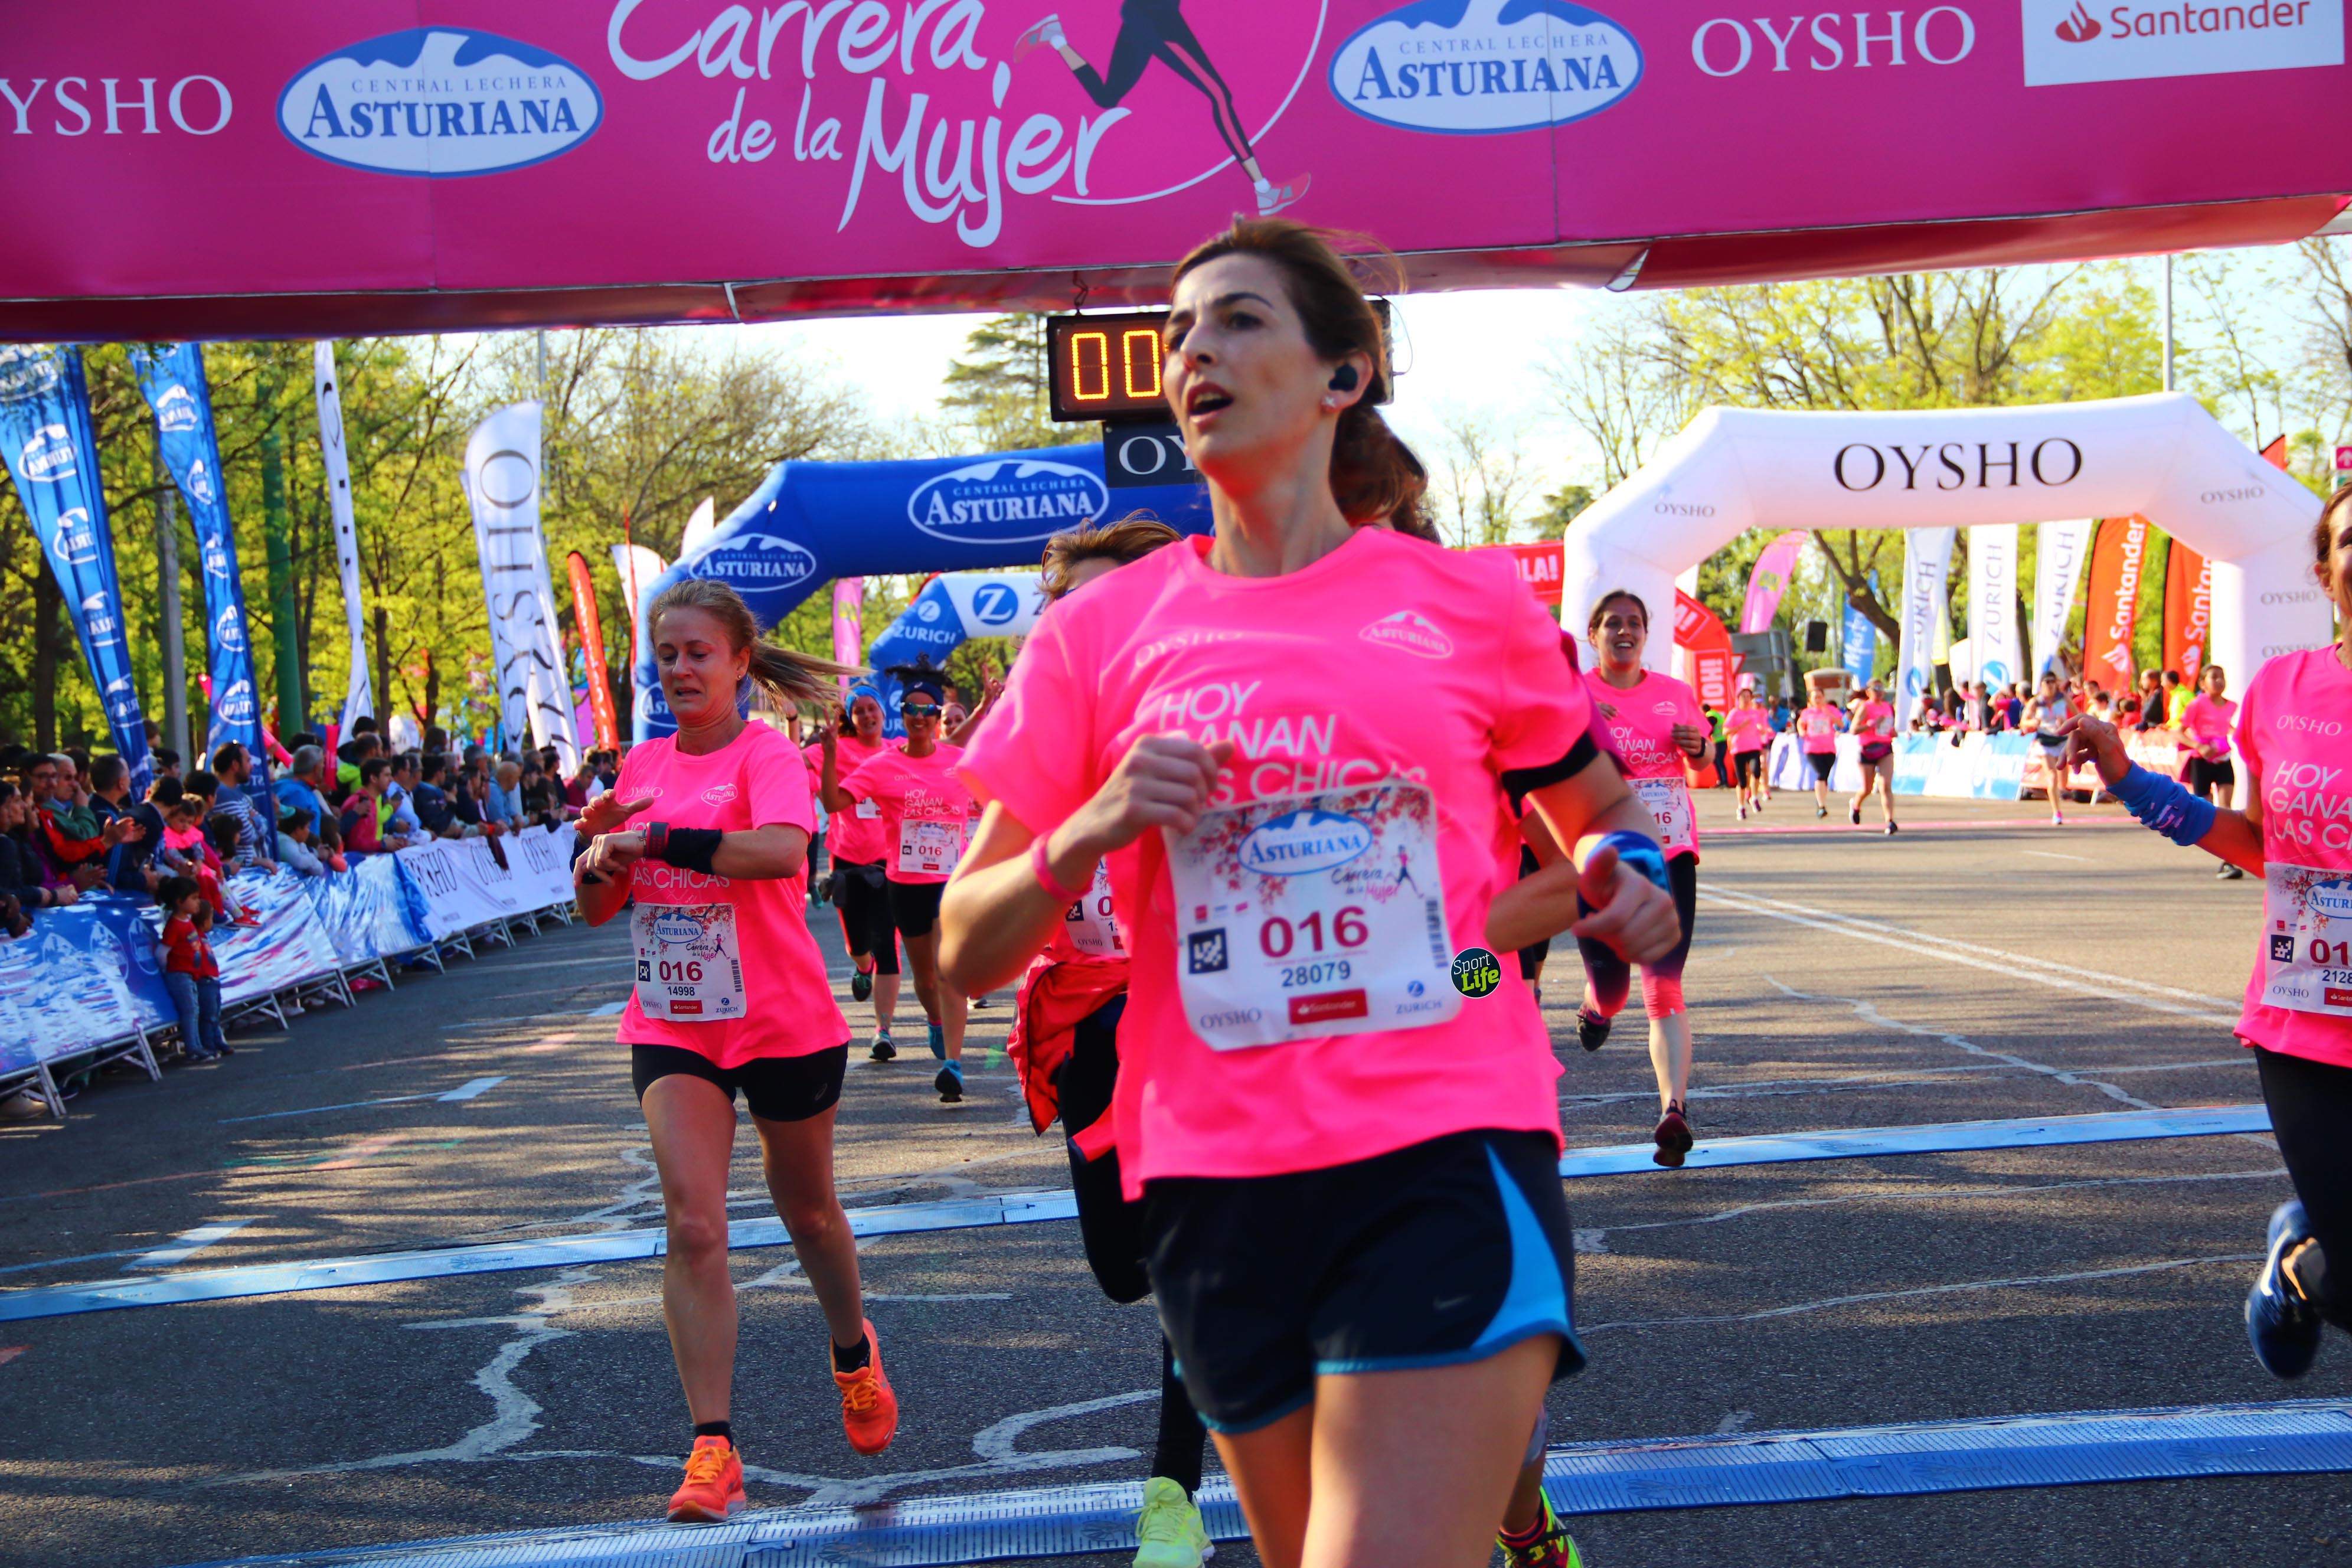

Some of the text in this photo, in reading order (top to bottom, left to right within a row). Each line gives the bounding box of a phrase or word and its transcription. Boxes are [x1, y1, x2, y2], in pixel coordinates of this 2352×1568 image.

[2110, 0, 2311, 40] Santander
[606, 0, 988, 81] Carrera
[1399, 33, 1609, 55] CENTRAL LECHERA
[1691, 5, 1976, 77] OYSHO
[351, 74, 567, 94] CENTRAL LECHERA
[1353, 45, 1622, 101] ASTURIANA
[0, 74, 233, 136] YSHO
[303, 82, 580, 139] ASTURIANA
[707, 61, 1132, 248] de la Mujer
[1834, 437, 2084, 492] OYSHO
[953, 479, 1086, 496] CENTRAL LECHERA
[2200, 485, 2265, 504] OYSHO
[924, 489, 1094, 527] ASTURIANA
[1655, 502, 1716, 518] OYSHO
[697, 556, 806, 577] ASTURIANA
[2110, 519, 2147, 641] Santander
[1985, 544, 2003, 645] ZURICH
[2260, 590, 2317, 605] OYSHO
[894, 627, 956, 645] ZURICH
[1370, 626, 1448, 654] ASTURIANA
[1159, 680, 1262, 732] HOY
[2276, 715, 2342, 736] OYSHO
[1174, 714, 1338, 761] ANAN
[2272, 760, 2343, 790] HOY
[904, 797, 943, 808] GANAN
[905, 788, 927, 800] HOY
[2268, 786, 2352, 823] GANA
[904, 805, 961, 818] LAS CHICAS
[1653, 811, 1672, 825] 16
[2272, 815, 2314, 846] LAS
[919, 845, 942, 856] 016
[1248, 835, 1363, 865] ASTURIANA
[1331, 866, 1384, 884] Carrera
[1363, 883, 1400, 904] Mujer
[656, 922, 700, 936] ASTURIANA
[1259, 905, 1370, 959] 016
[685, 942, 709, 951] Carrera
[700, 950, 718, 962] Mujer
[2309, 938, 2349, 966] 01
[658, 960, 703, 982] 016
[1281, 960, 1352, 988] 28079
[2322, 969, 2352, 985] 2128
[667, 985, 695, 997] 14998
[2272, 985, 2309, 999] OYSHO
[1308, 999, 1357, 1014] Santander
[1395, 1001, 1442, 1015] ZURICH
[1200, 1007, 1263, 1030] OYSHO
